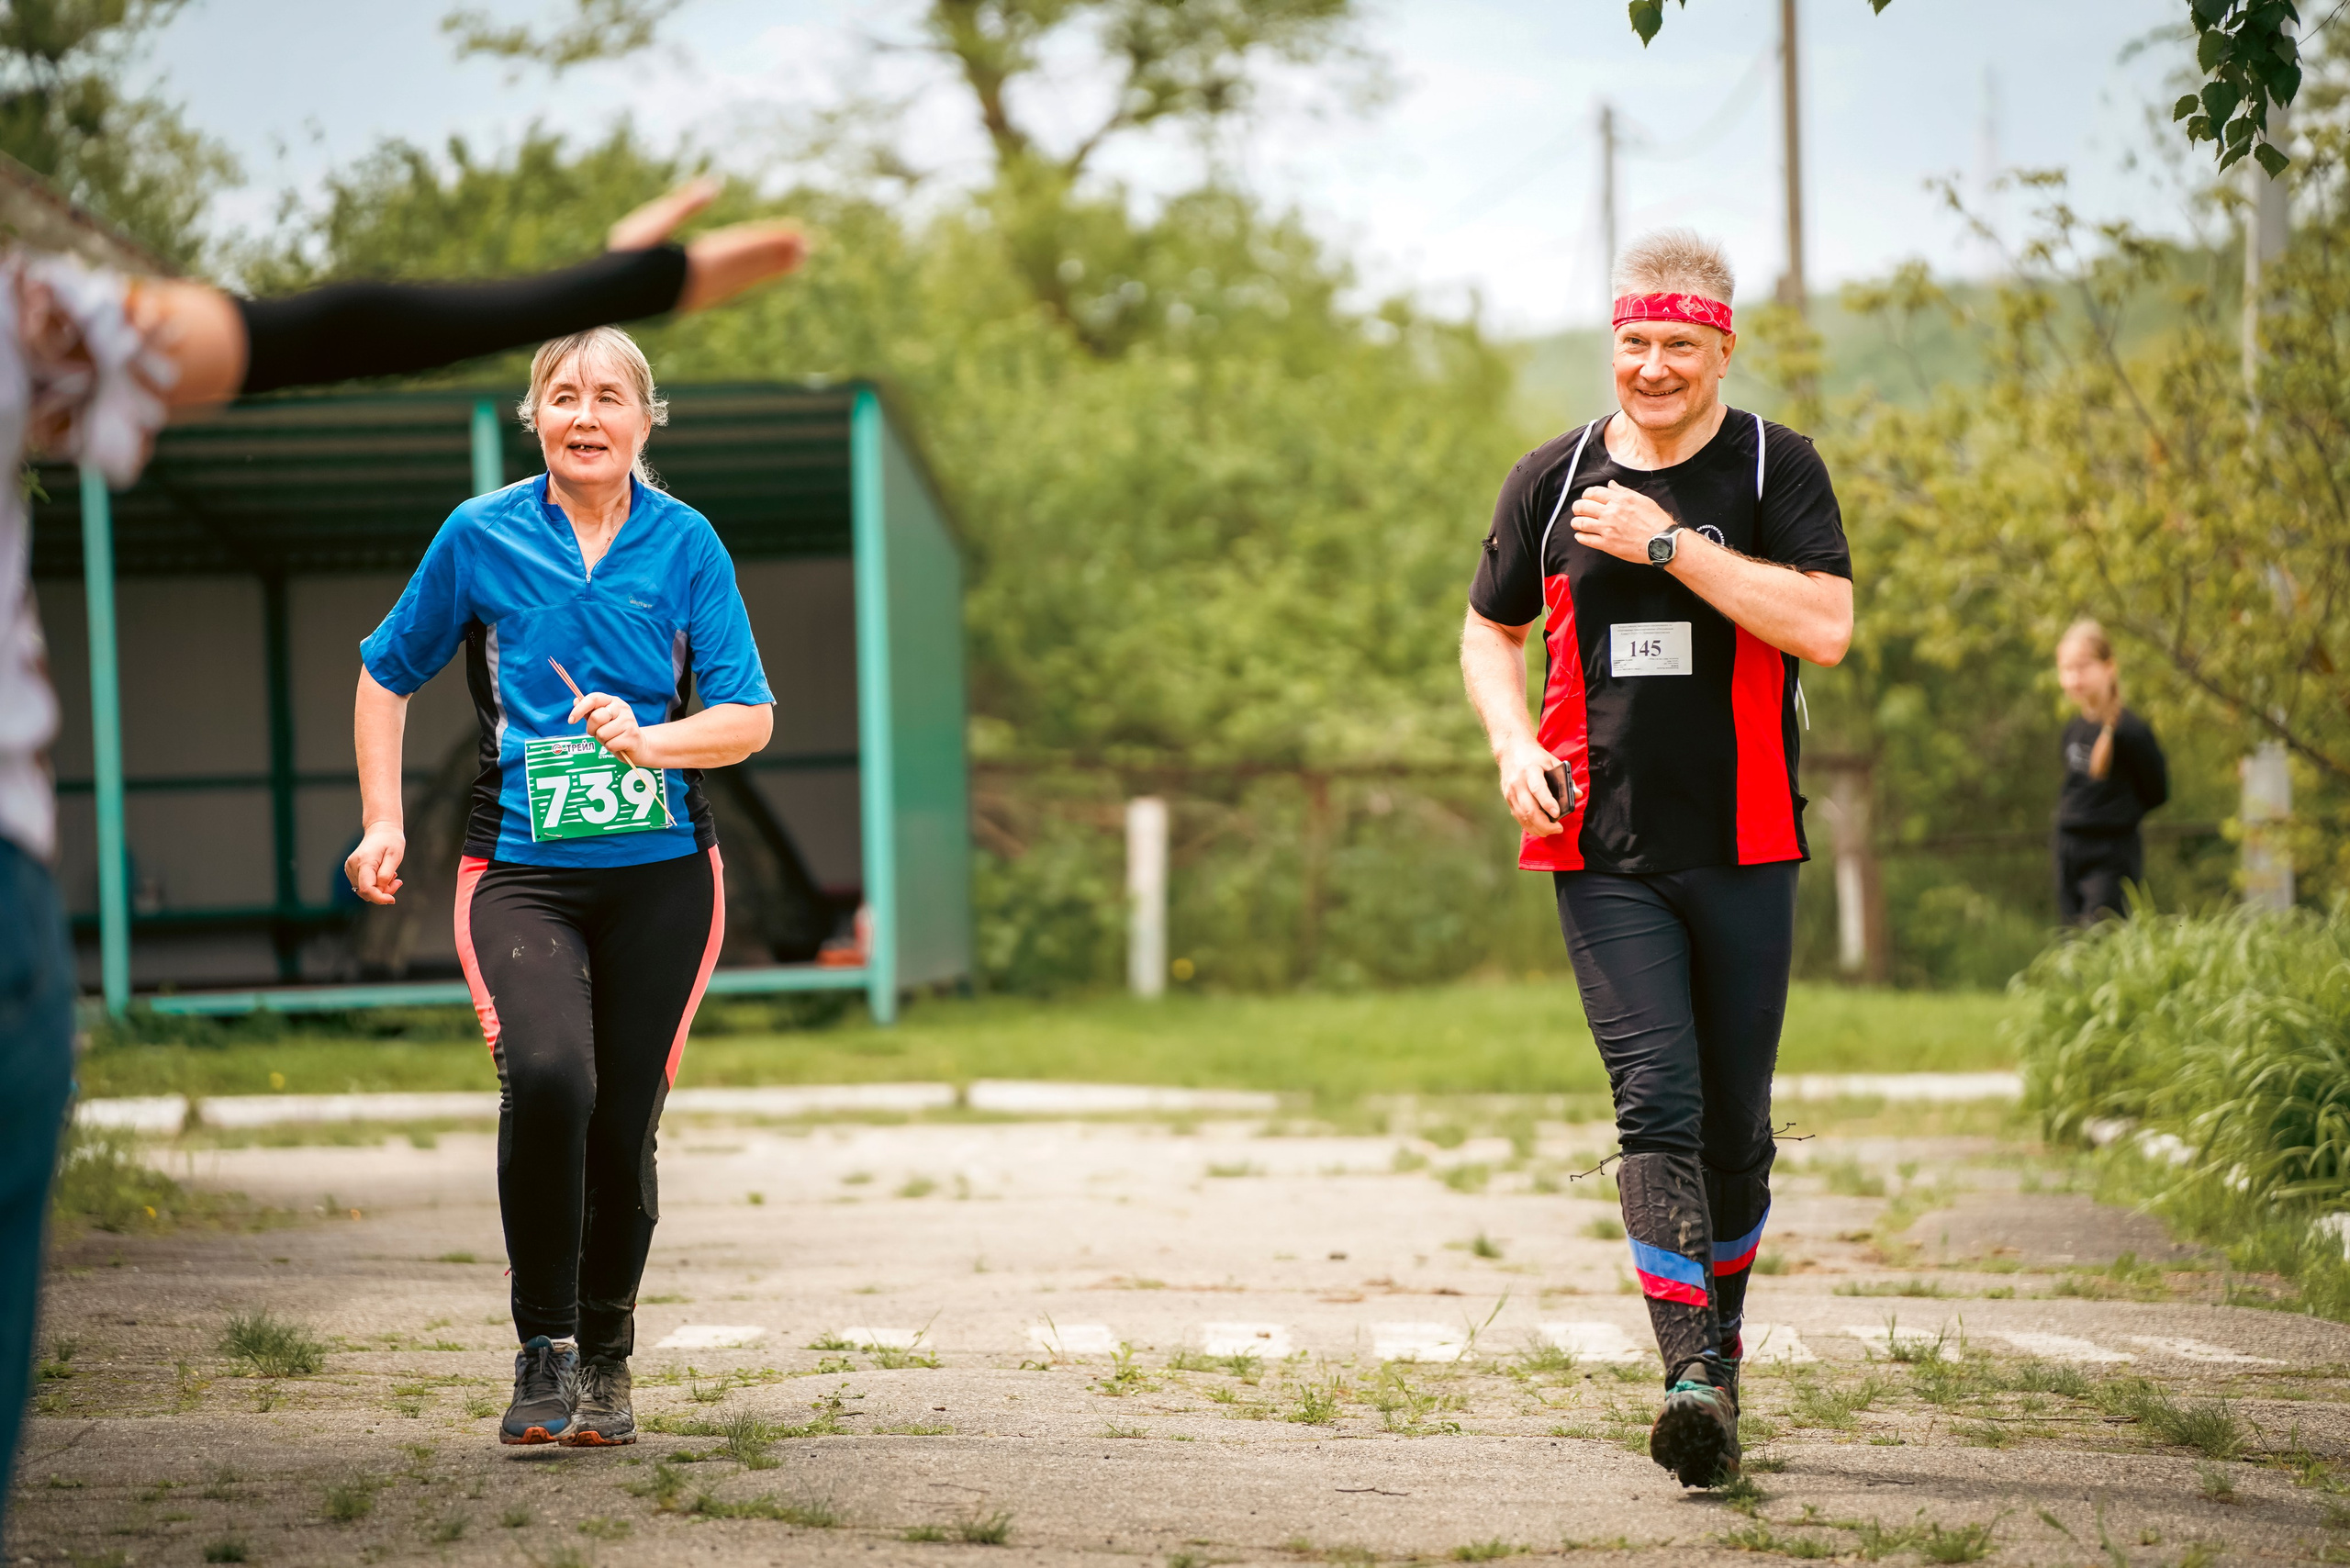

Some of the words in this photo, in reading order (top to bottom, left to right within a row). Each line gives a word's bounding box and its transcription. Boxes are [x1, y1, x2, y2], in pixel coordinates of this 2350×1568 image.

[1696, 524, 1725, 546] ОРИЕНТИРОВАНИ
[1630, 640, 1662, 657] 145
[536, 767, 657, 829] 739
